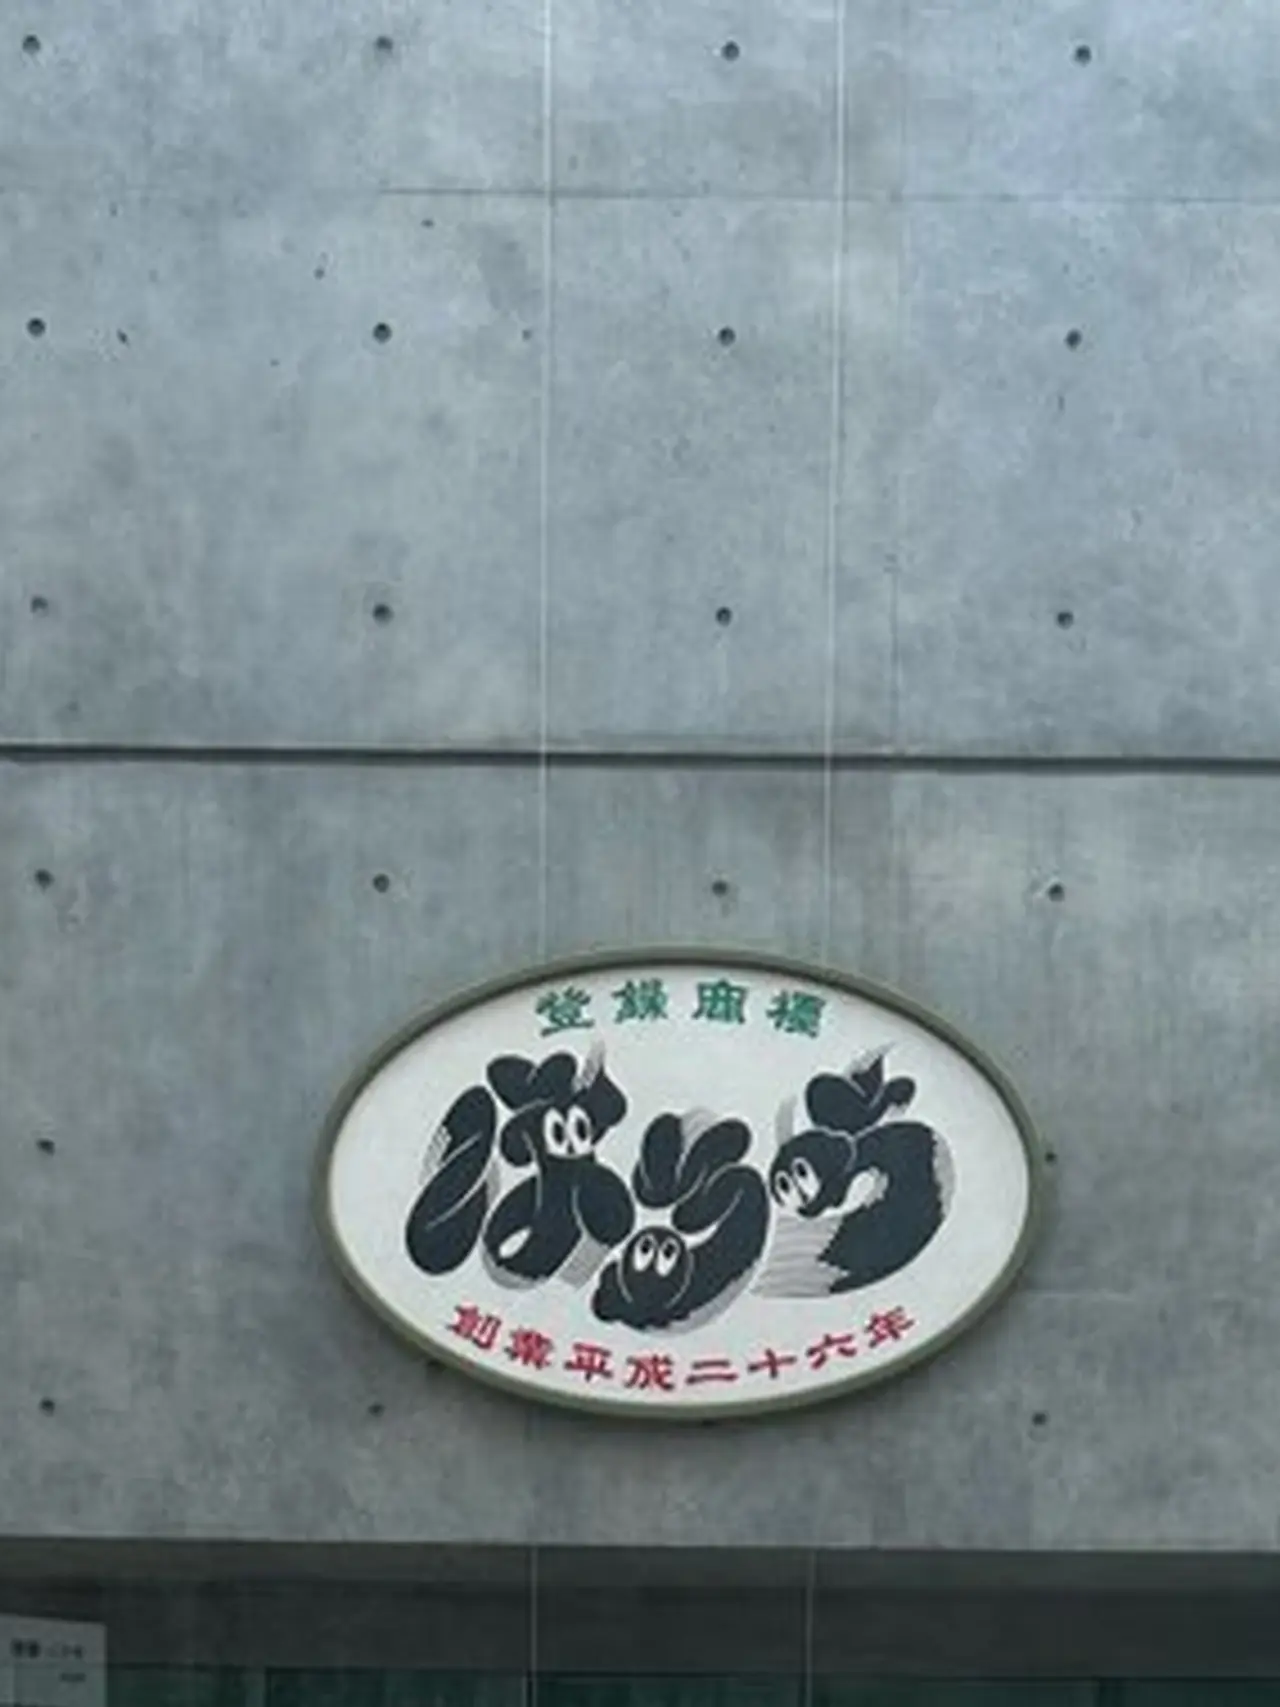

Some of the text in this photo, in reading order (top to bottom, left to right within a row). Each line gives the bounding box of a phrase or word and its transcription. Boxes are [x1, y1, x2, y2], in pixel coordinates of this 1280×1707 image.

[446, 1303, 917, 1392] 創業平成二十六年
